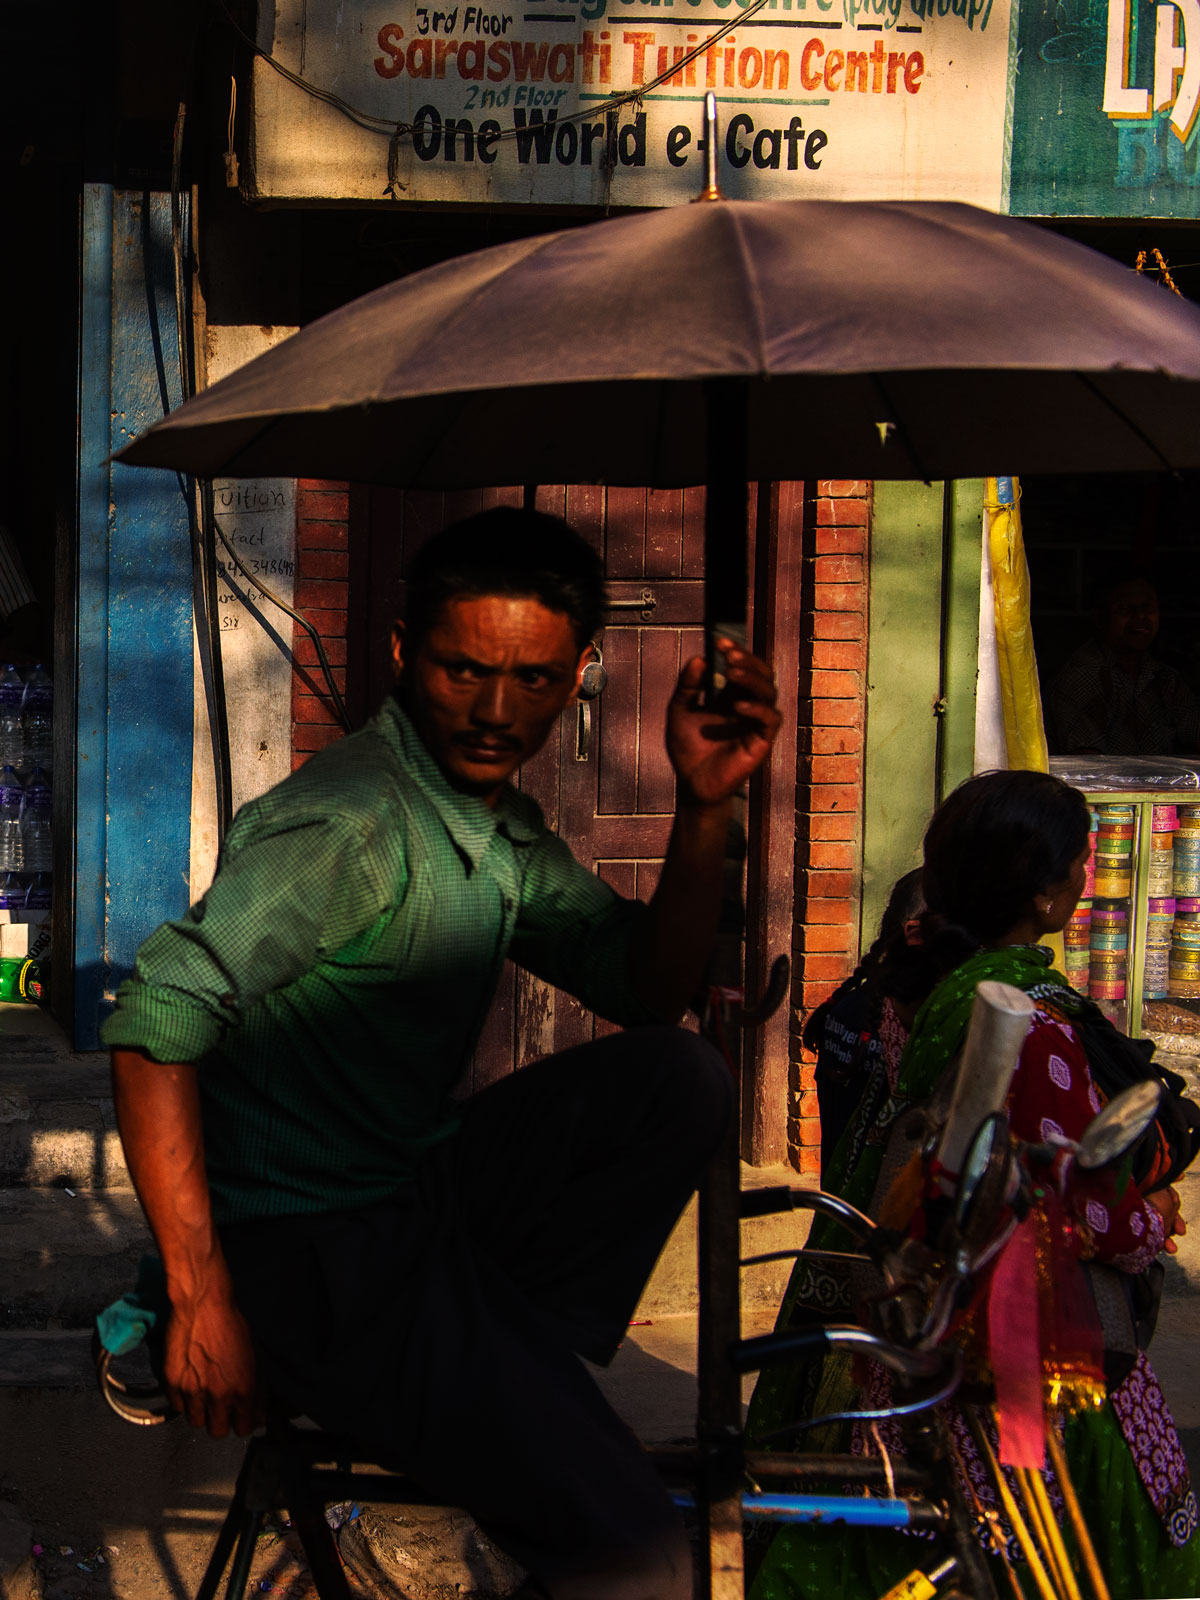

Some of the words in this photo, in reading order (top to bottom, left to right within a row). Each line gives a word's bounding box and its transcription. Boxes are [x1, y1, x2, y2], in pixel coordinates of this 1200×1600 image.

[416, 7, 458, 35] 3rd
[464, 7, 513, 37] Floor
[374, 23, 612, 85] Saraswati
[623, 31, 790, 89] Tuition
[800, 38, 925, 94] Centre
[464, 85, 512, 110] 2nd
[514, 85, 569, 107] Floor
[412, 104, 500, 164] One
[513, 107, 647, 167] World
